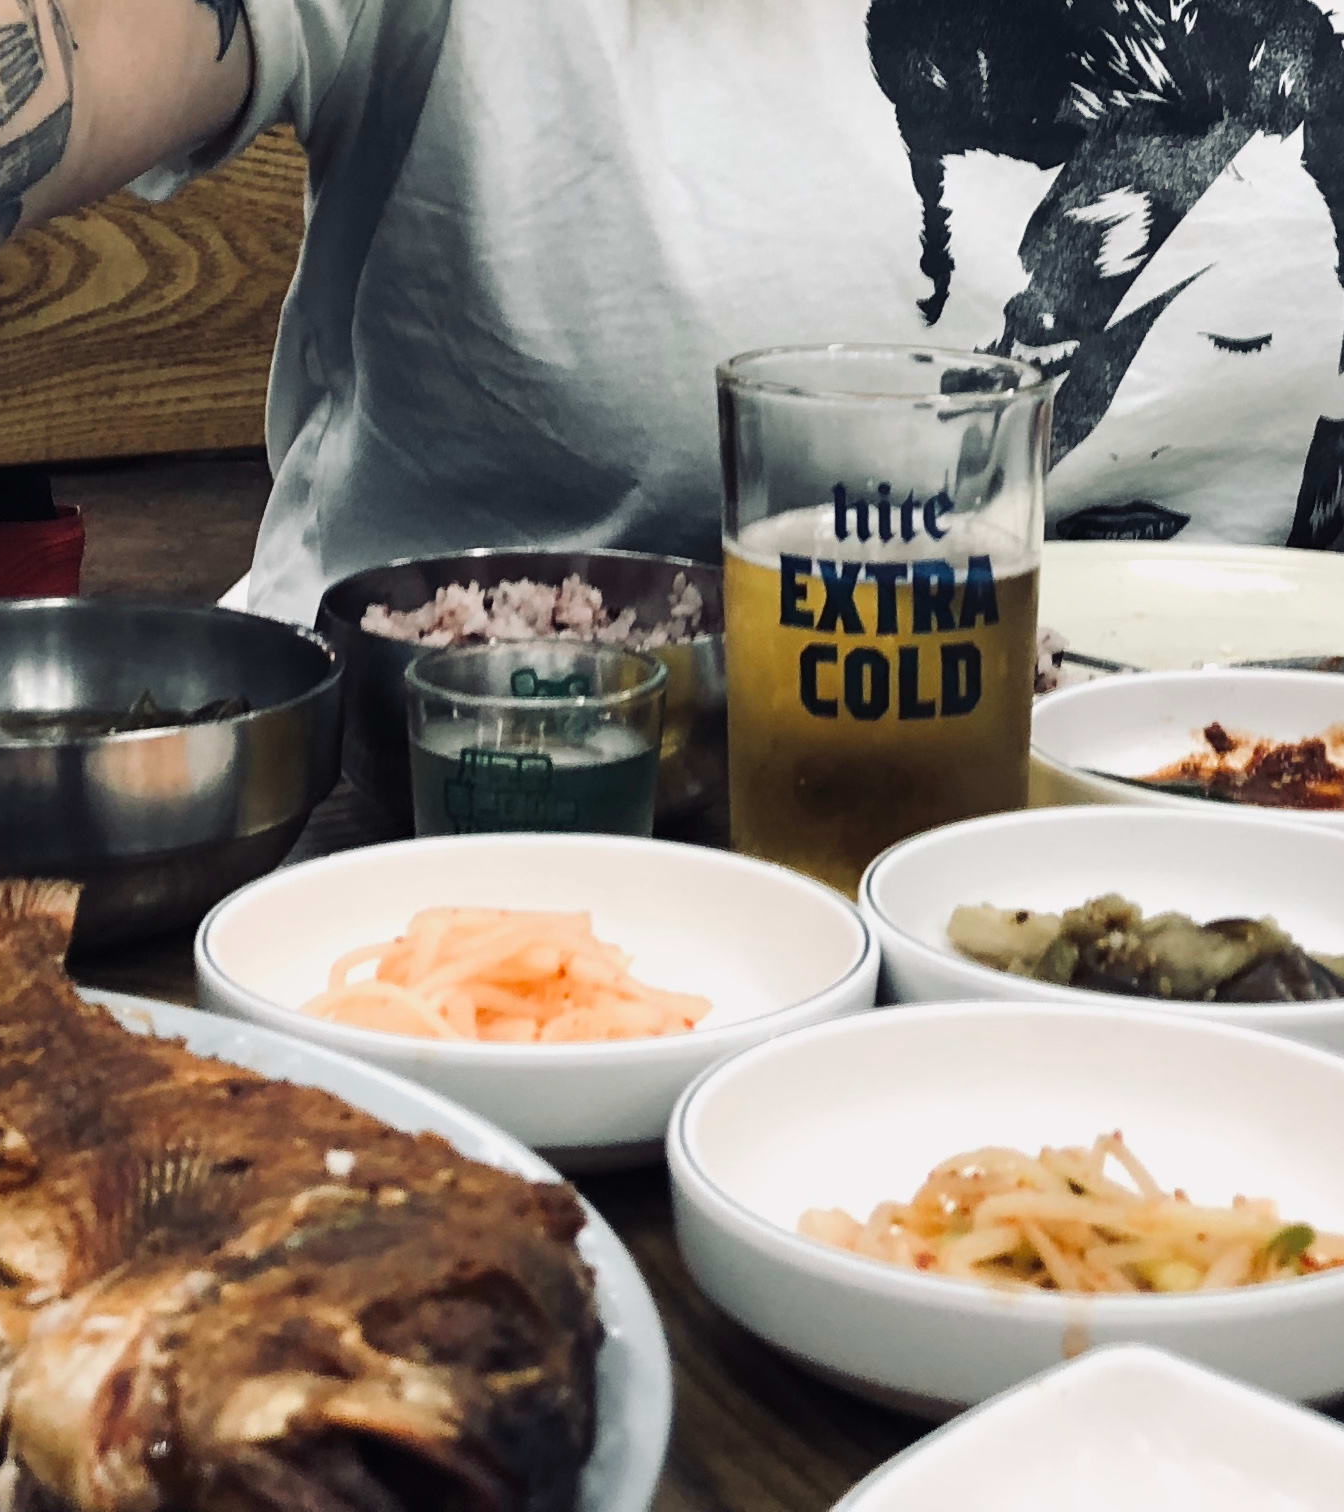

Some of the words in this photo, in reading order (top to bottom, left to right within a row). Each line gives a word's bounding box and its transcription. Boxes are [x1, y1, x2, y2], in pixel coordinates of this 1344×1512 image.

[833, 481, 954, 543] hite
[779, 551, 1000, 636] EXTRA
[799, 640, 983, 722] COLD
